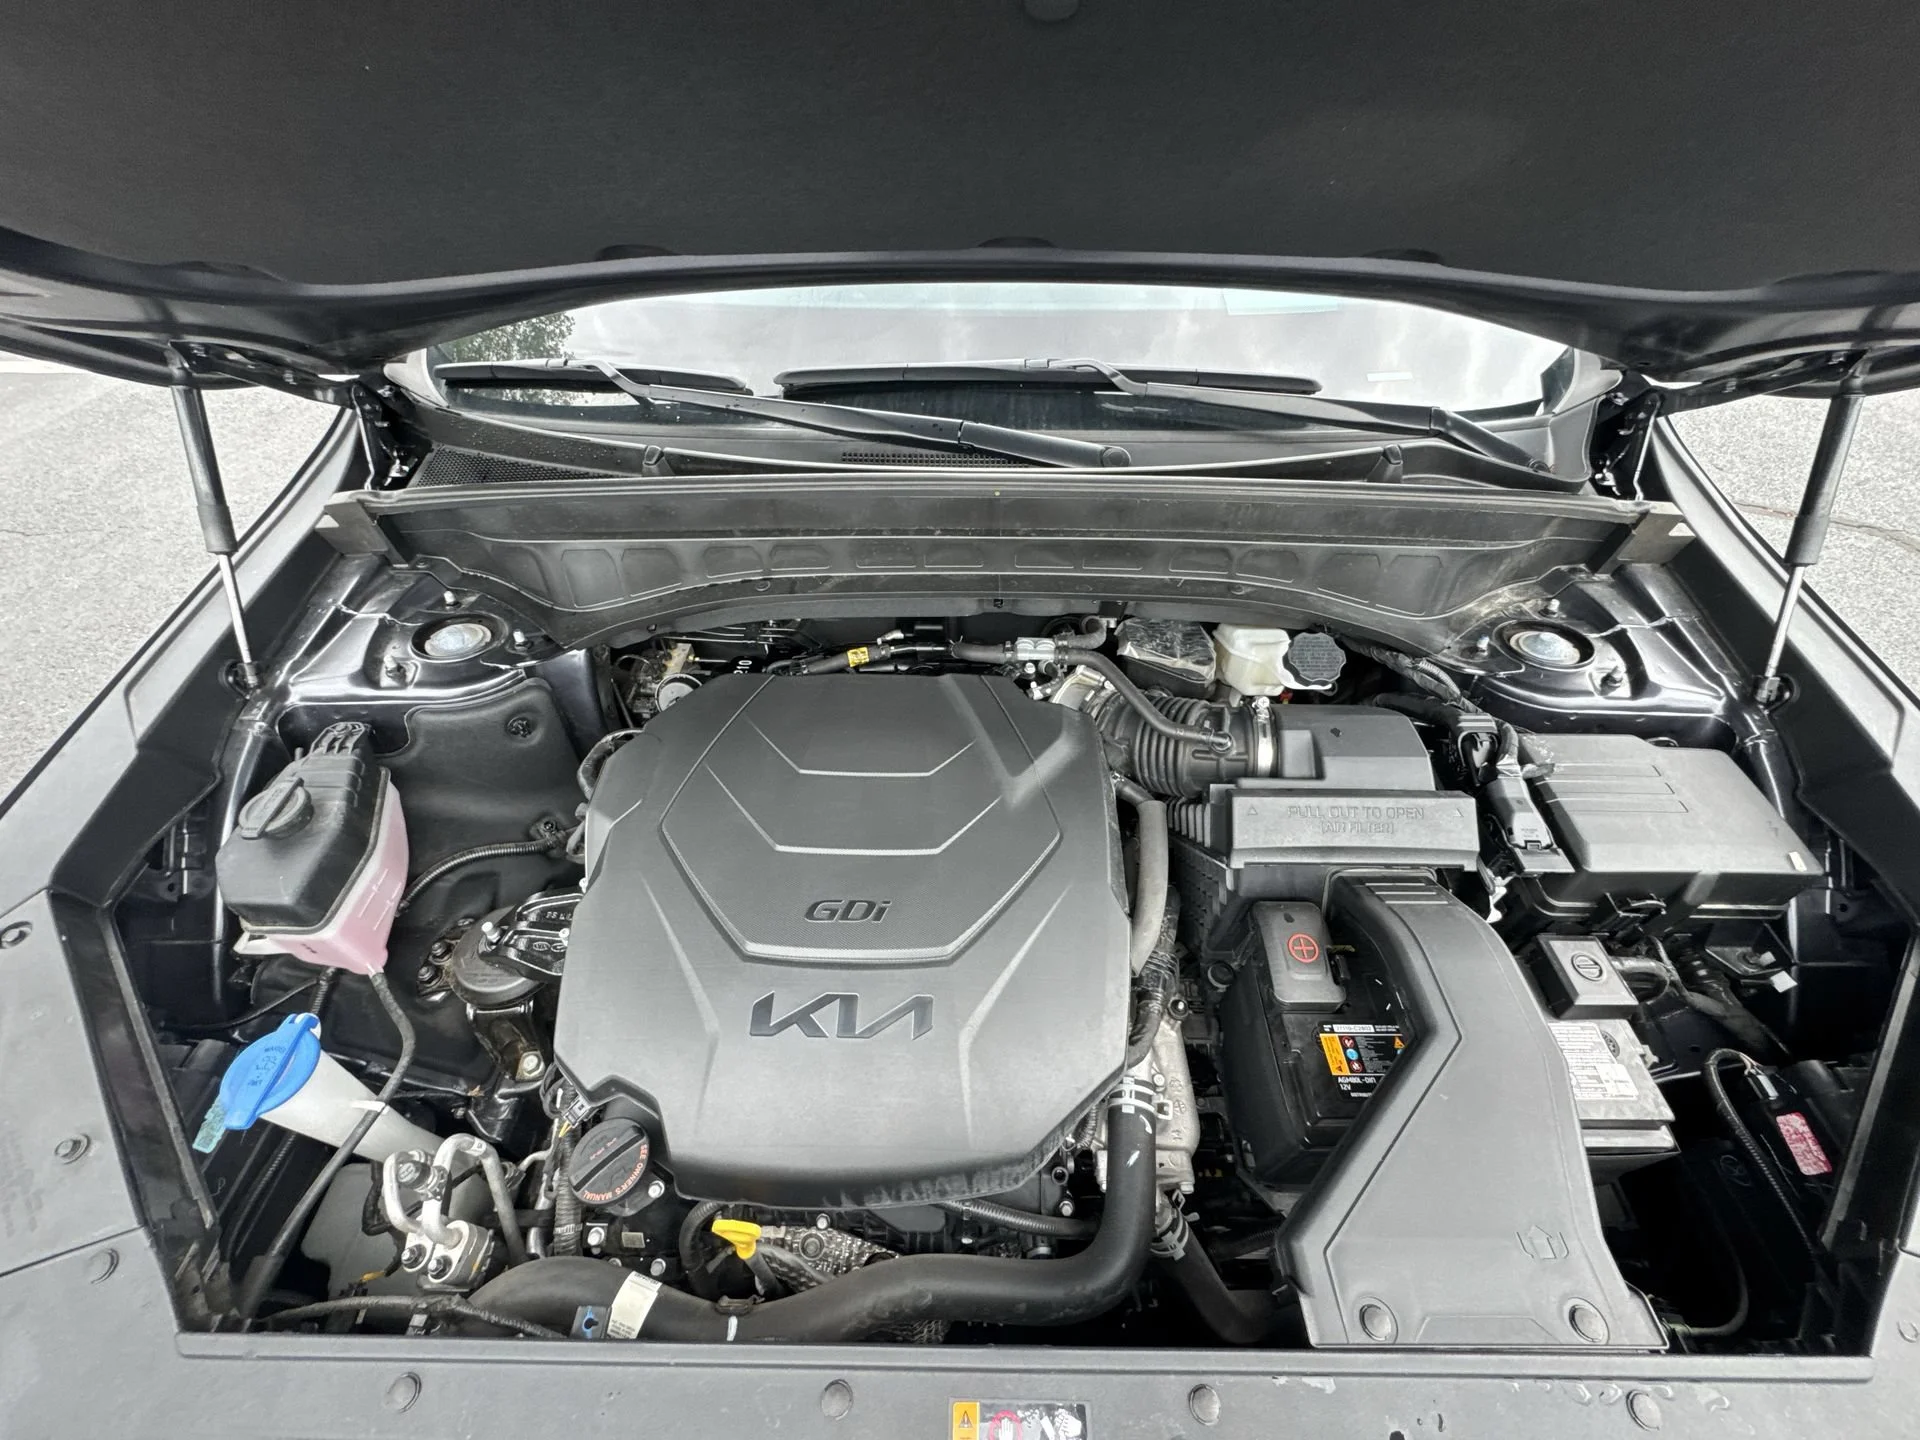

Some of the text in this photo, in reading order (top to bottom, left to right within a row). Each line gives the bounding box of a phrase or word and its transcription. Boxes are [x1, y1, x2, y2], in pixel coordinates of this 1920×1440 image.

[1287, 805, 1425, 820] PULL OUT TO OPEN
[749, 990, 935, 1041] KIA
[639, 1143, 648, 1160] SEE
[582, 1188, 613, 1202] MANUAL
